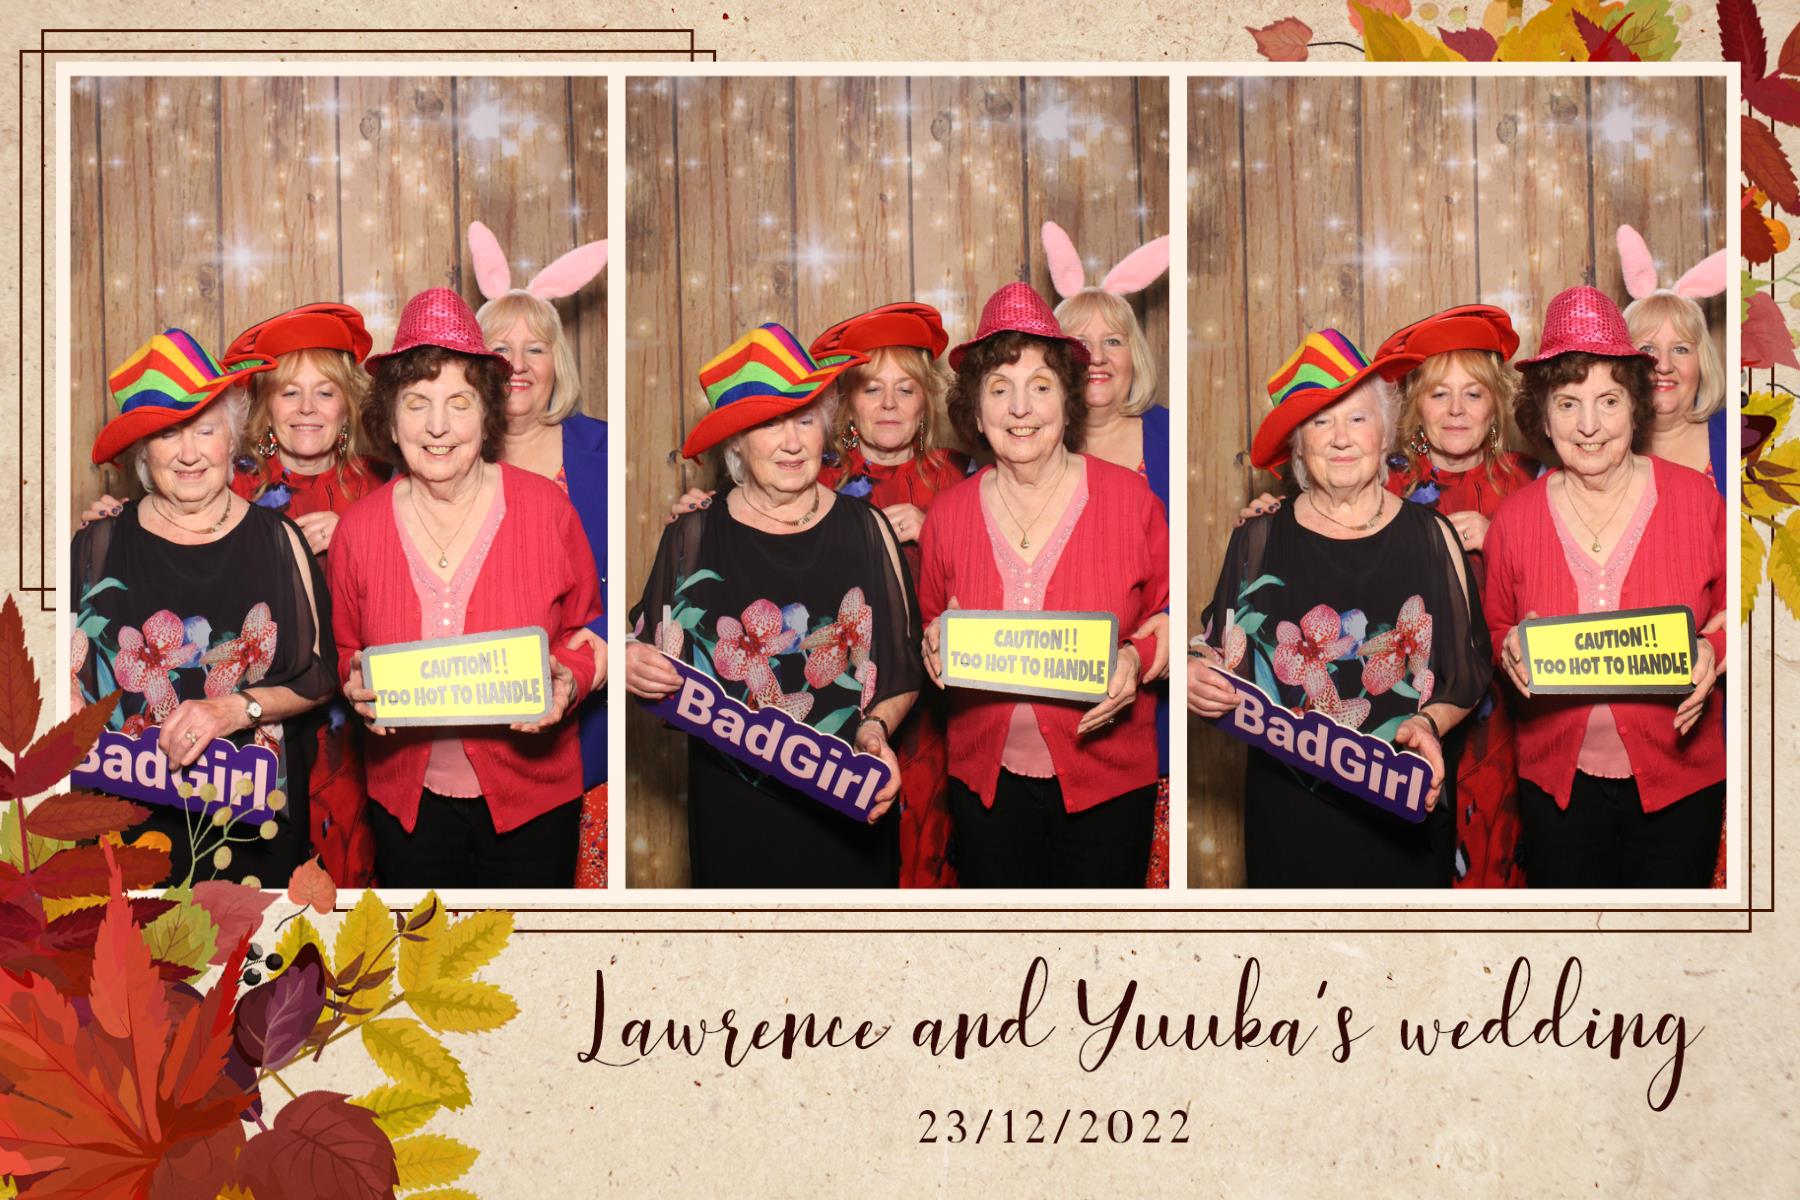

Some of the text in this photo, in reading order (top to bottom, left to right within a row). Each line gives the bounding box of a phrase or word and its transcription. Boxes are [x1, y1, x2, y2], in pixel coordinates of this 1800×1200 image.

[994, 628, 1078, 653] CAUTION!!
[1574, 623, 1658, 651] CAUTION!!
[420, 648, 509, 680] CAUTION!!
[951, 651, 1105, 684] TOO HOT TO HANDLE
[1534, 652, 1689, 676] TOO HOT TO HANDLE
[377, 678, 542, 706] TOO HOT TO HANDLE
[676, 676, 882, 811] BadGirl
[1234, 688, 1424, 811] BadGirl
